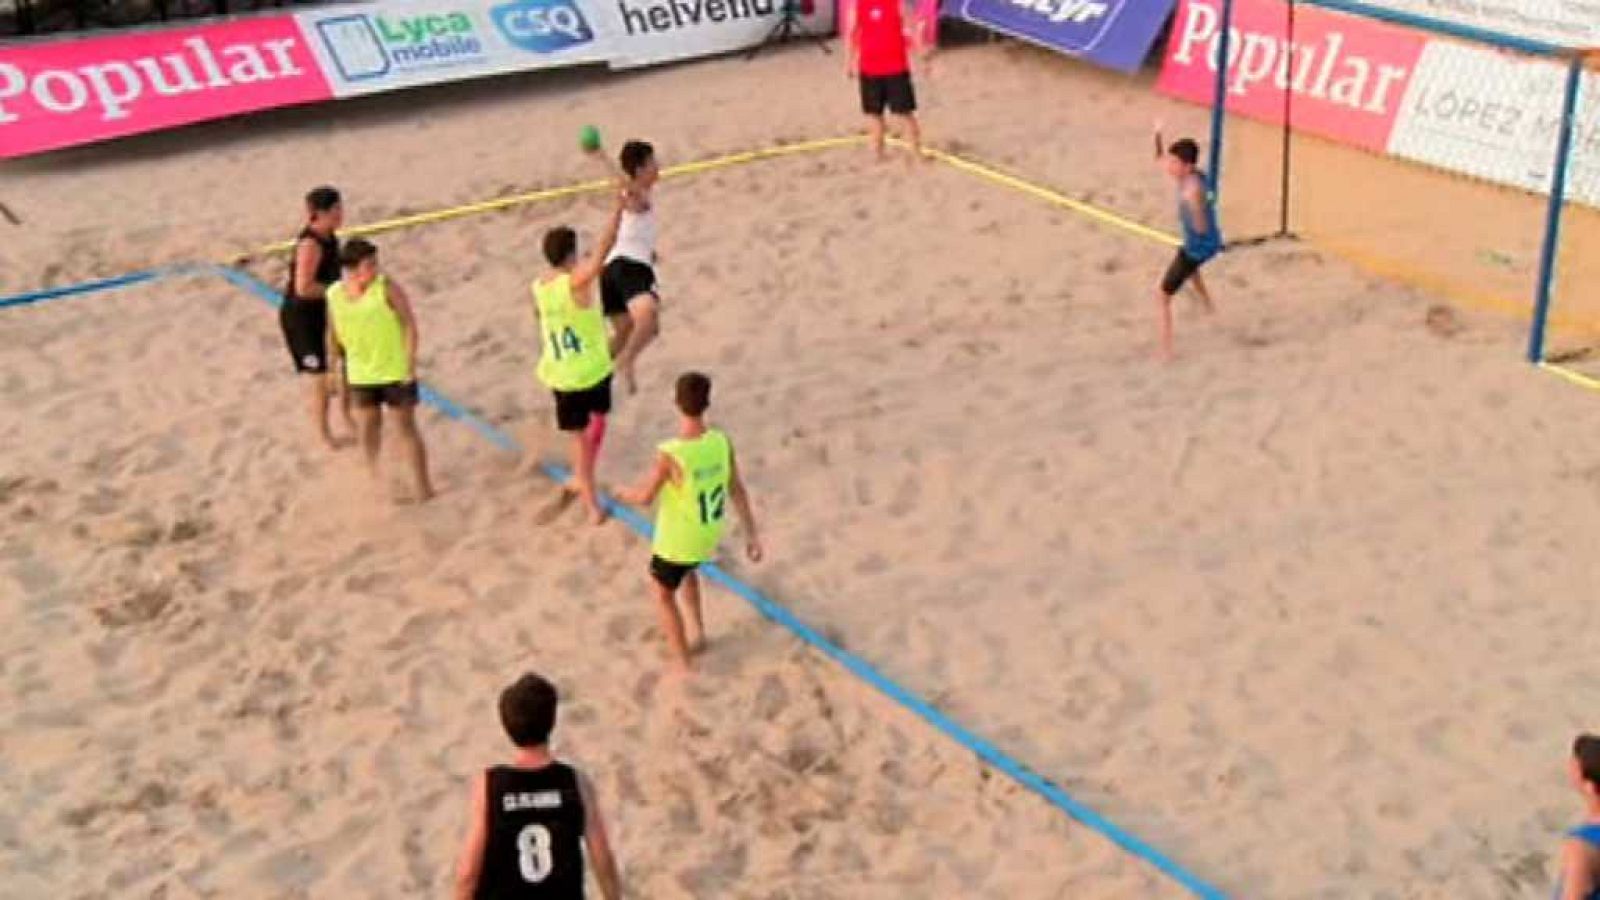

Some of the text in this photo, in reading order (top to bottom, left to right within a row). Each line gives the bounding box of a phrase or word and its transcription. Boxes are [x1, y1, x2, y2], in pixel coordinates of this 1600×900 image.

[375, 11, 473, 43] Lyca
[391, 36, 481, 63] mobile
[1173, 2, 1406, 115] Popular
[550, 325, 581, 361] 14
[697, 483, 726, 525] 12
[516, 822, 553, 883] 8
